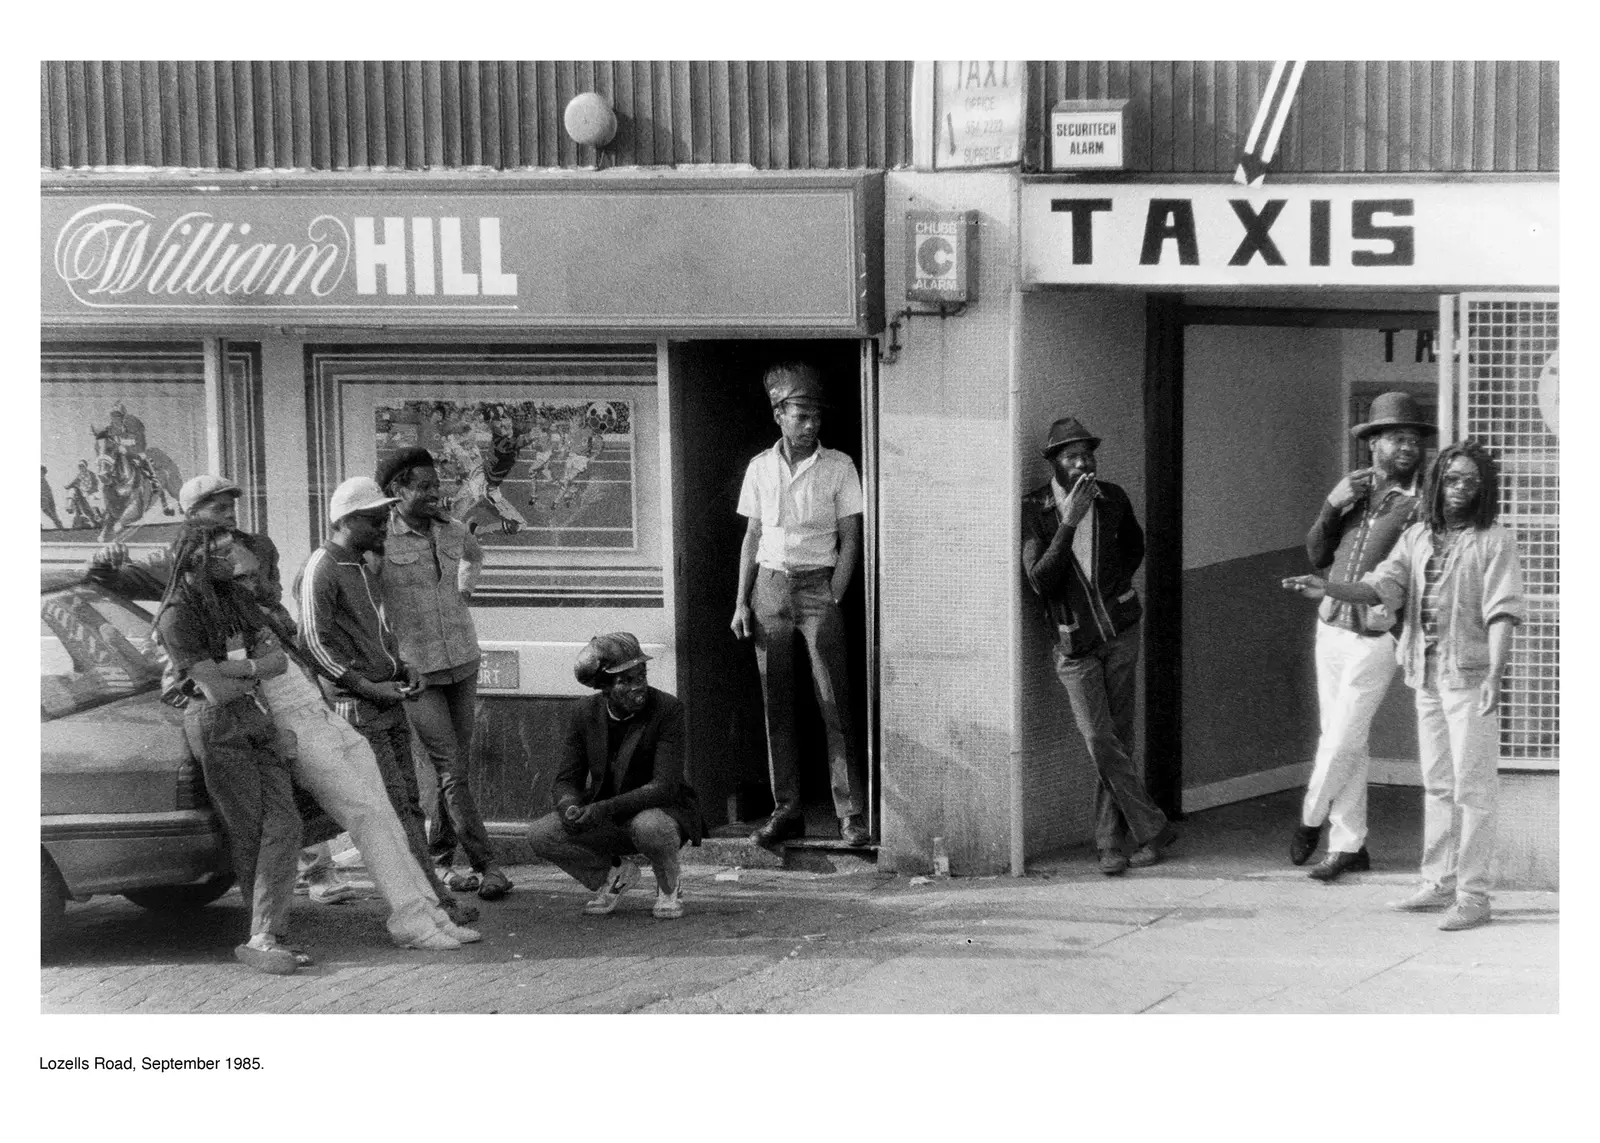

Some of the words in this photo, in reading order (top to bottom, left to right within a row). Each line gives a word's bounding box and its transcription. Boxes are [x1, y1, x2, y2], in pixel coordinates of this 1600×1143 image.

[1056, 122, 1117, 137] SECURITECH
[1070, 141, 1104, 155] ALARM
[915, 222, 957, 234] CHUBB
[1051, 198, 1414, 267] TAXIS
[54, 203, 349, 297] William
[354, 217, 518, 295] HILL
[913, 279, 957, 291] ALARM
[1379, 328, 1440, 362] TA
